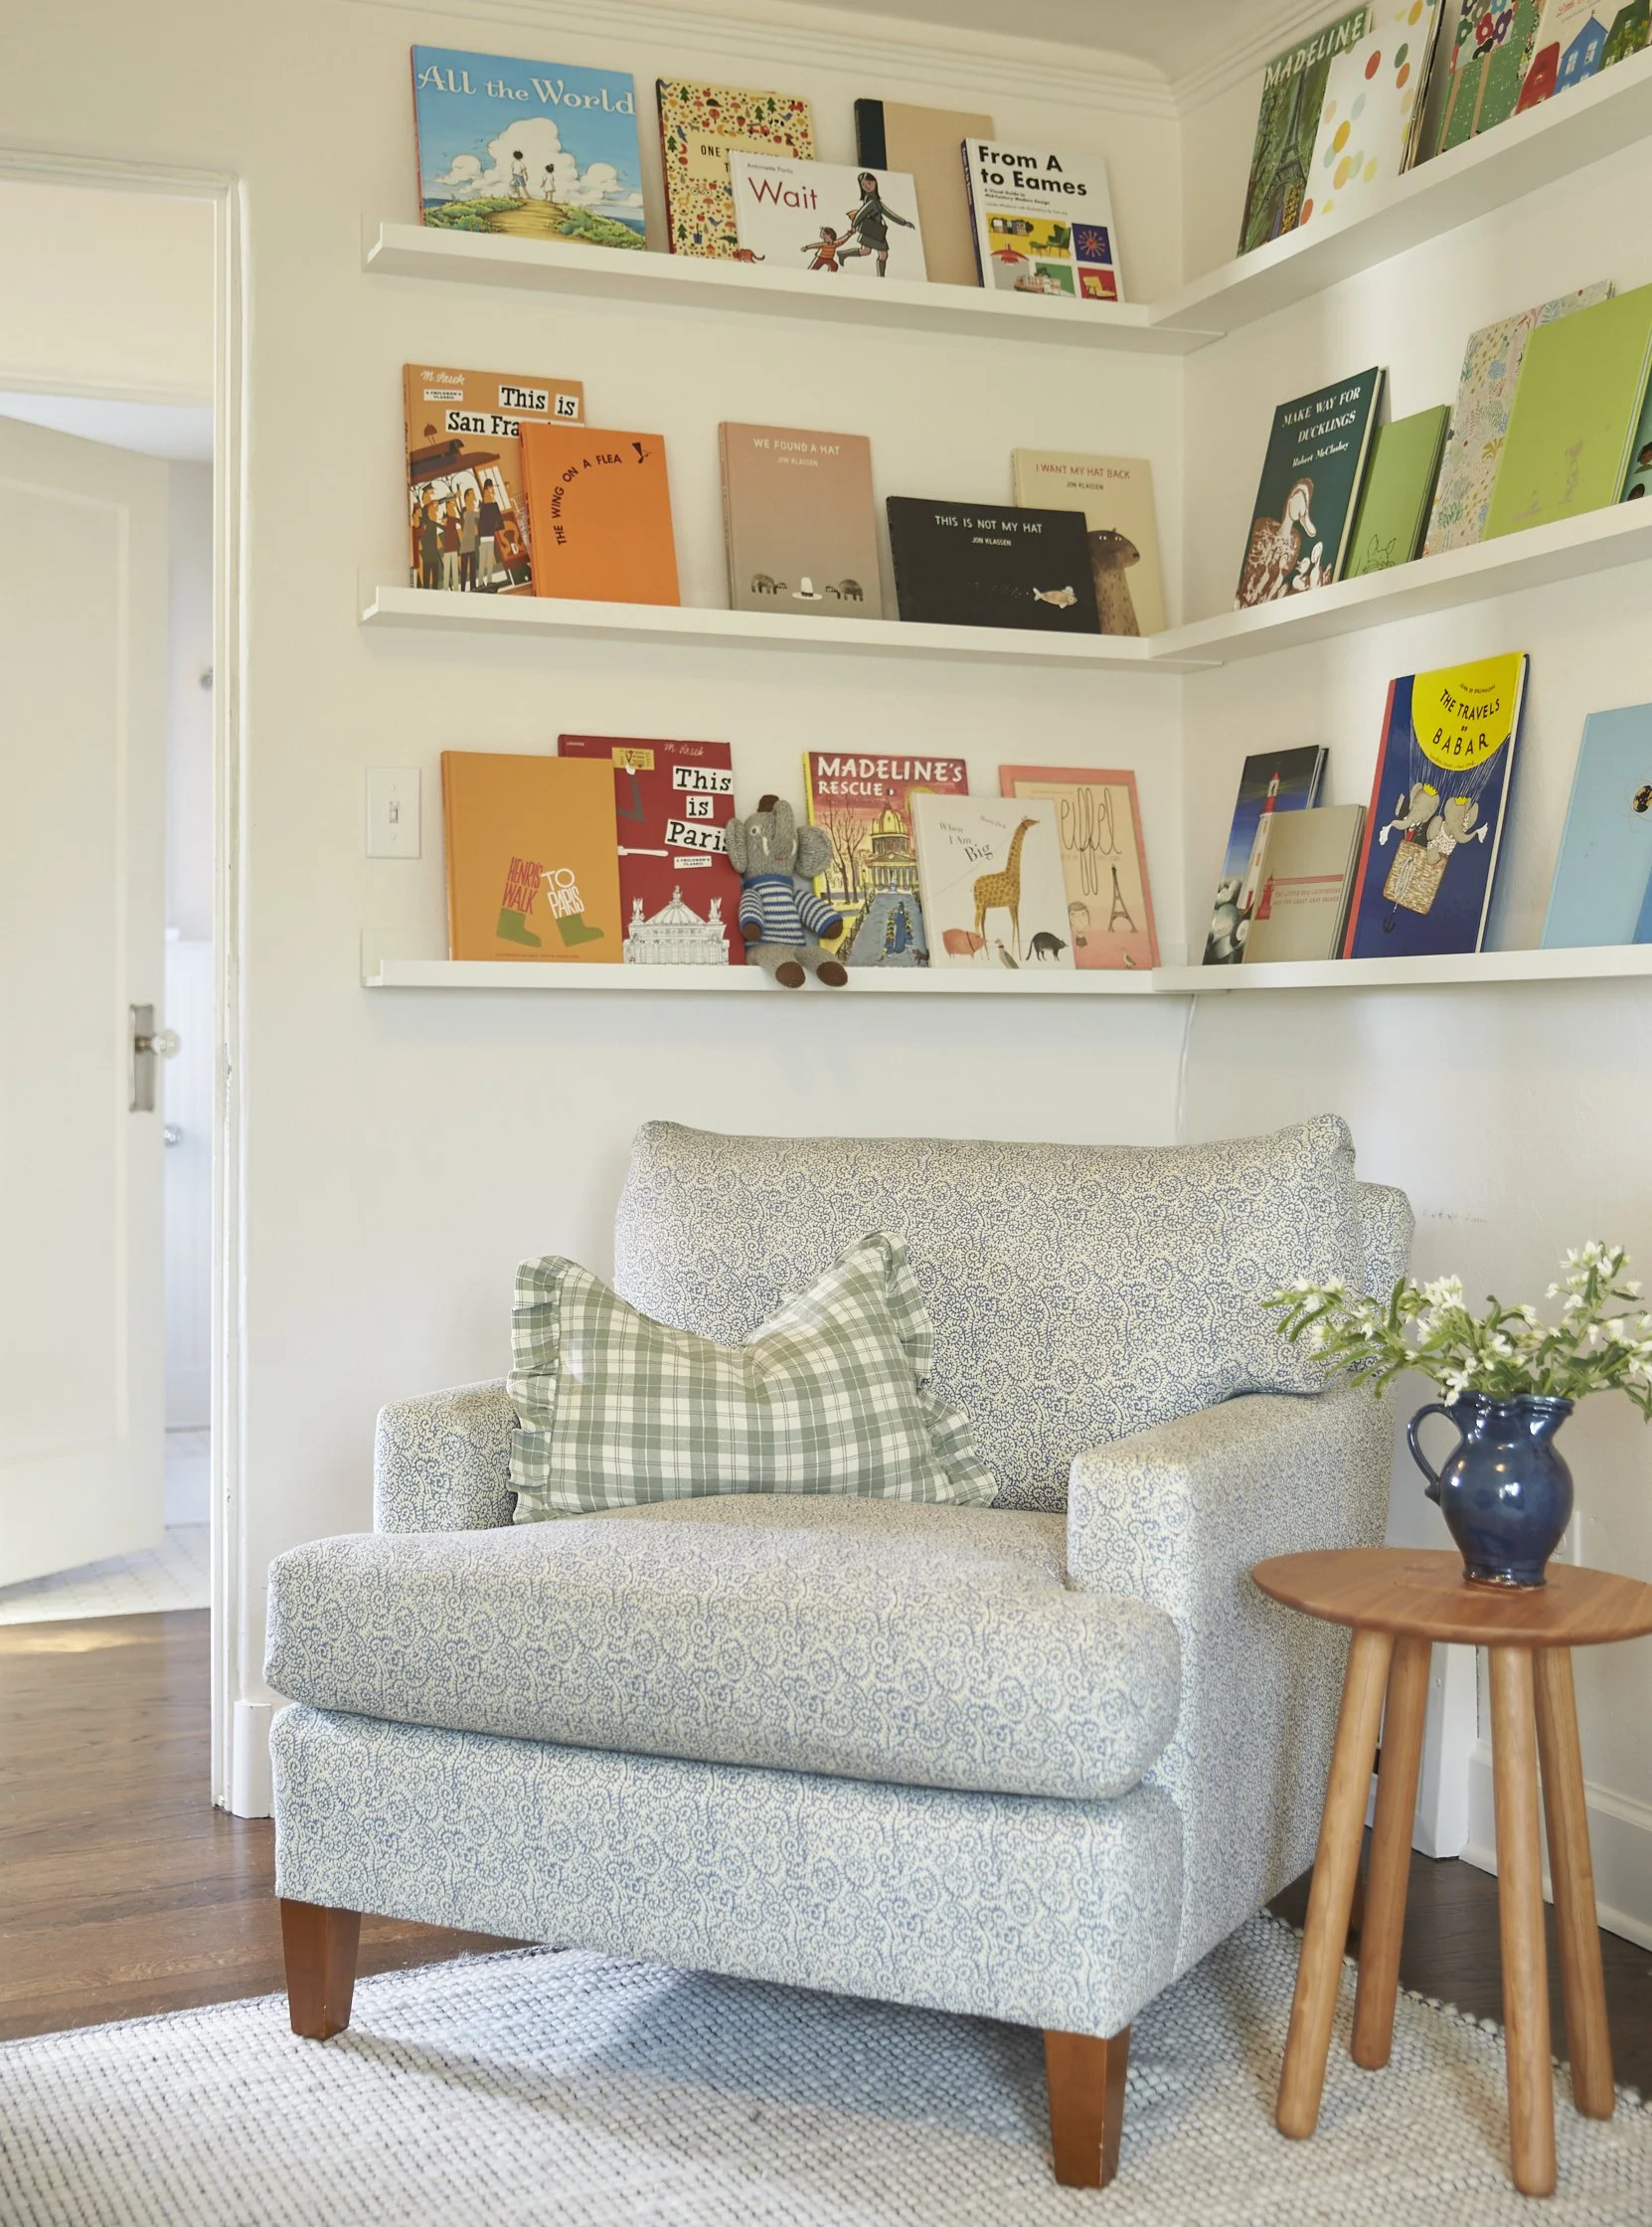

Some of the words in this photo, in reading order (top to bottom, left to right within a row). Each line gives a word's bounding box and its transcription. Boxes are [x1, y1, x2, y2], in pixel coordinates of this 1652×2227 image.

[1264, 12, 1365, 91] MADELINE
[416, 66, 477, 95] All
[485, 80, 530, 101] the
[529, 78, 636, 115] World
[701, 145, 721, 157] ONE
[977, 145, 1038, 169] From
[1046, 155, 1064, 173] A
[747, 177, 818, 211] Wait
[980, 168, 1005, 186] to
[1012, 171, 1088, 196] Eames
[501, 387, 546, 410] This
[557, 396, 576, 417] is
[1282, 406, 1312, 428] MAKE
[1316, 395, 1337, 414] WAY
[1339, 386, 1361, 407] FOR
[447, 412, 486, 434] San
[1297, 410, 1357, 444] DUCKLINGS
[595, 453, 623, 465] FLEA
[753, 437, 770, 449] WE
[774, 439, 808, 453] FOUND
[810, 443, 817, 453] A
[819, 444, 841, 456] HAT
[562, 466, 579, 483] ON
[582, 458, 592, 469] A
[551, 486, 566, 519] WING
[553, 525, 568, 545] THE
[934, 515, 959, 528] THIS
[962, 518, 973, 529] IS
[977, 519, 997, 530] NOT
[1001, 521, 1019, 533] MY
[1022, 522, 1043, 534] HAT
[1439, 688, 1457, 713] THE
[1456, 698, 1500, 721] TRAVELS
[1432, 728, 1489, 756] BABAR
[675, 768, 732, 791] This
[818, 781, 884, 795] RESCUE
[688, 797, 709, 817] is
[964, 843, 994, 863] Big
[541, 868, 576, 892] TO
[502, 882, 538, 916] WALK
[547, 885, 584, 920] PARIS
